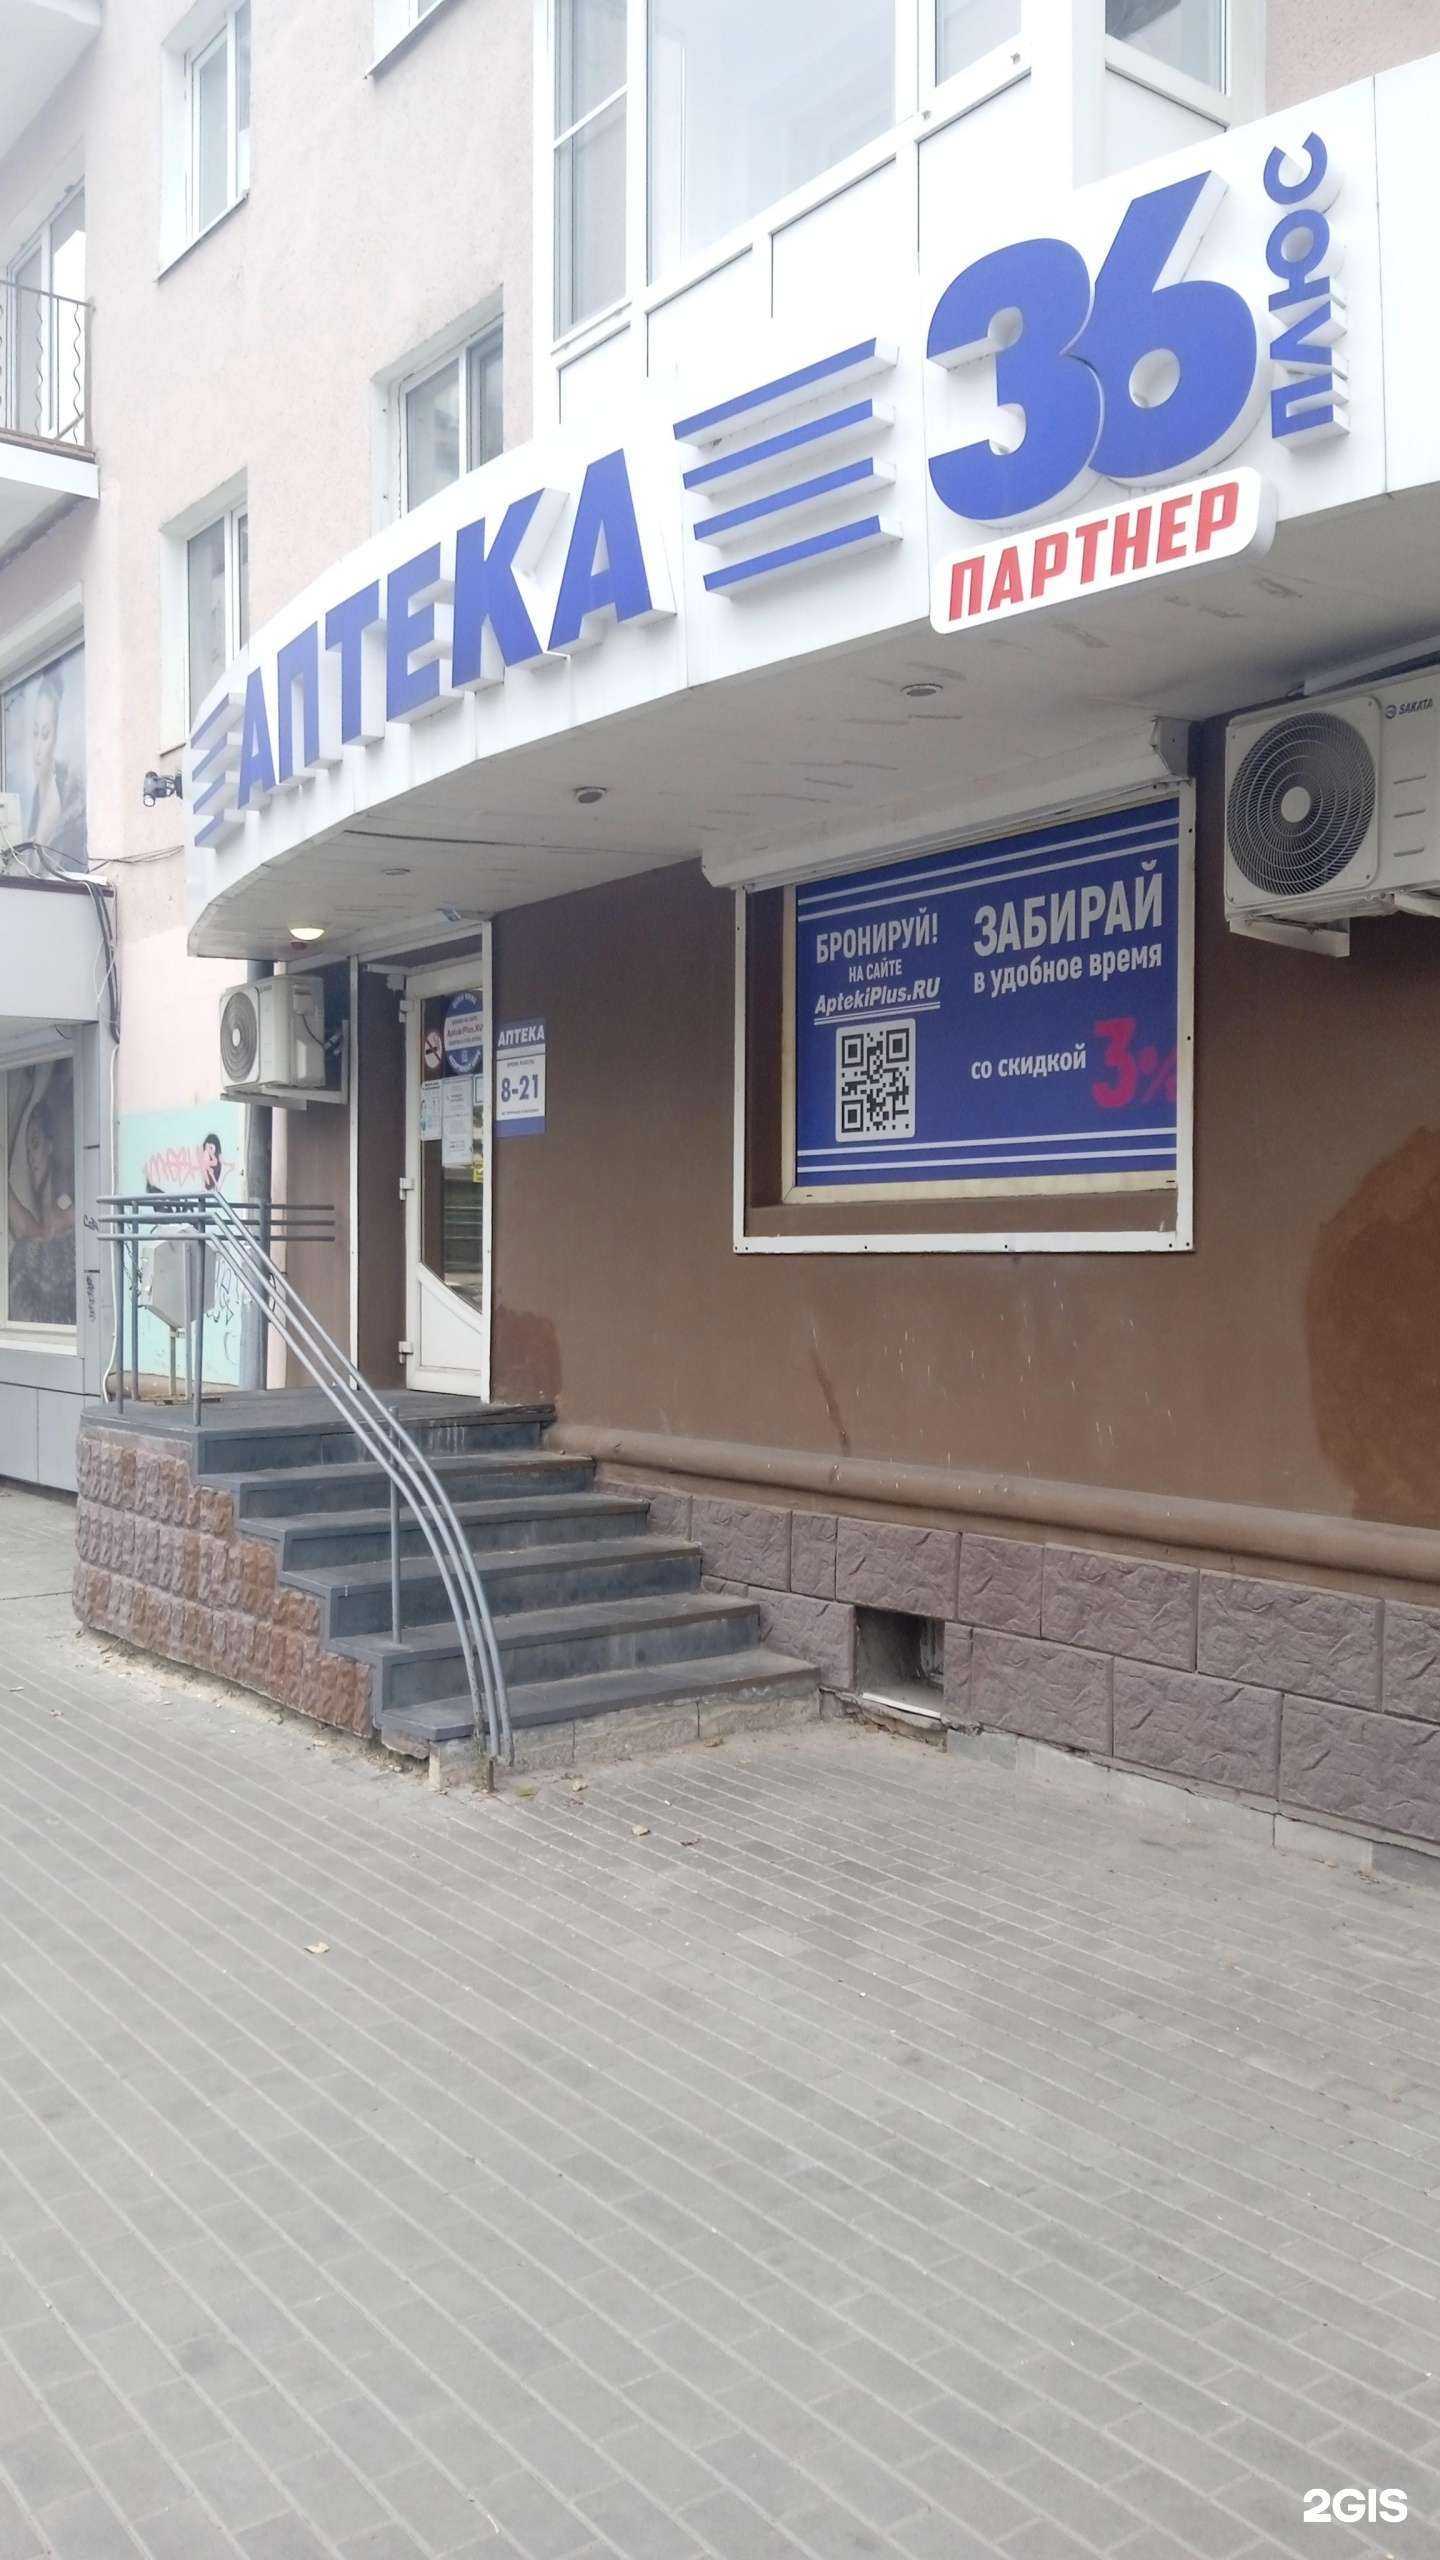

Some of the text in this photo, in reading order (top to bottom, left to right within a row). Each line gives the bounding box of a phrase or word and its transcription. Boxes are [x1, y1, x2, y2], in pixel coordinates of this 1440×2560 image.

[1263, 132, 1334, 439] ПЛЮС
[926, 170, 1258, 521] 36
[948, 481, 1240, 622] ПАРТНЕР
[238, 448, 654, 811] АПТЕКА
[1399, 698, 1433, 716] SAKATA
[816, 906, 939, 964] БРОНИРУЙ!
[973, 859, 1163, 957] ЗАБИРАЙ
[814, 977, 941, 1016] AptekiPlus.RU
[848, 957, 903, 983] НА САЙТЕ
[974, 943, 1162, 998] в удобное время
[497, 1025, 545, 1048] АПТЕКА
[971, 1060, 993, 1080] со
[998, 1042, 1087, 1078] скидкой
[501, 1074, 539, 1102] 8-21
